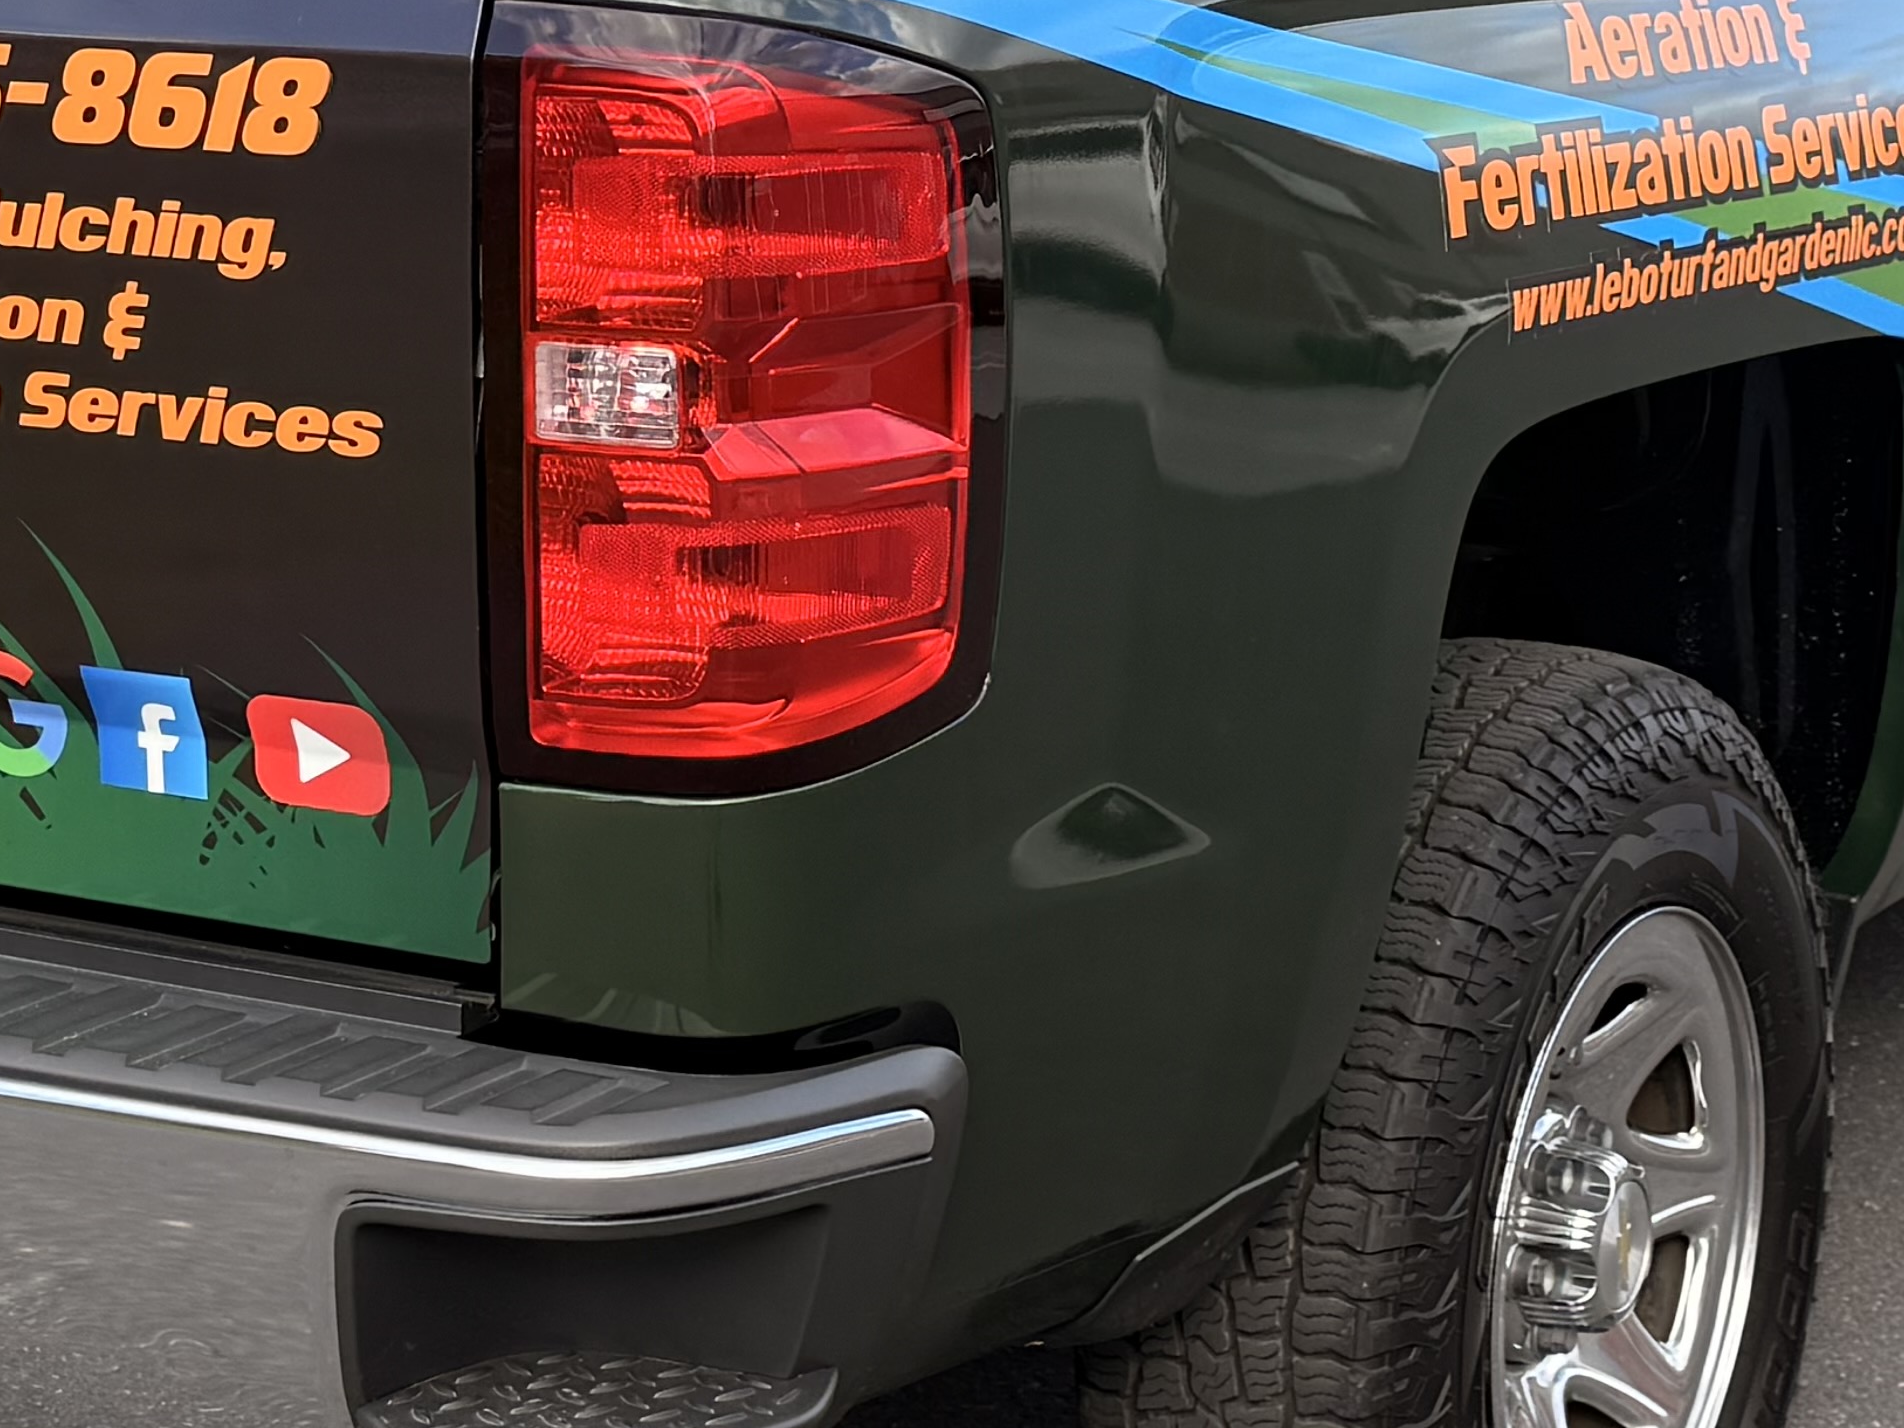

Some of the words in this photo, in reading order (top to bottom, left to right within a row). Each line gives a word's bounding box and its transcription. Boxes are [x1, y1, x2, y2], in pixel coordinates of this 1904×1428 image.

[1441, 115, 1759, 240] Fertilization
[103, 280, 149, 361] &
[18, 371, 386, 459] Services
